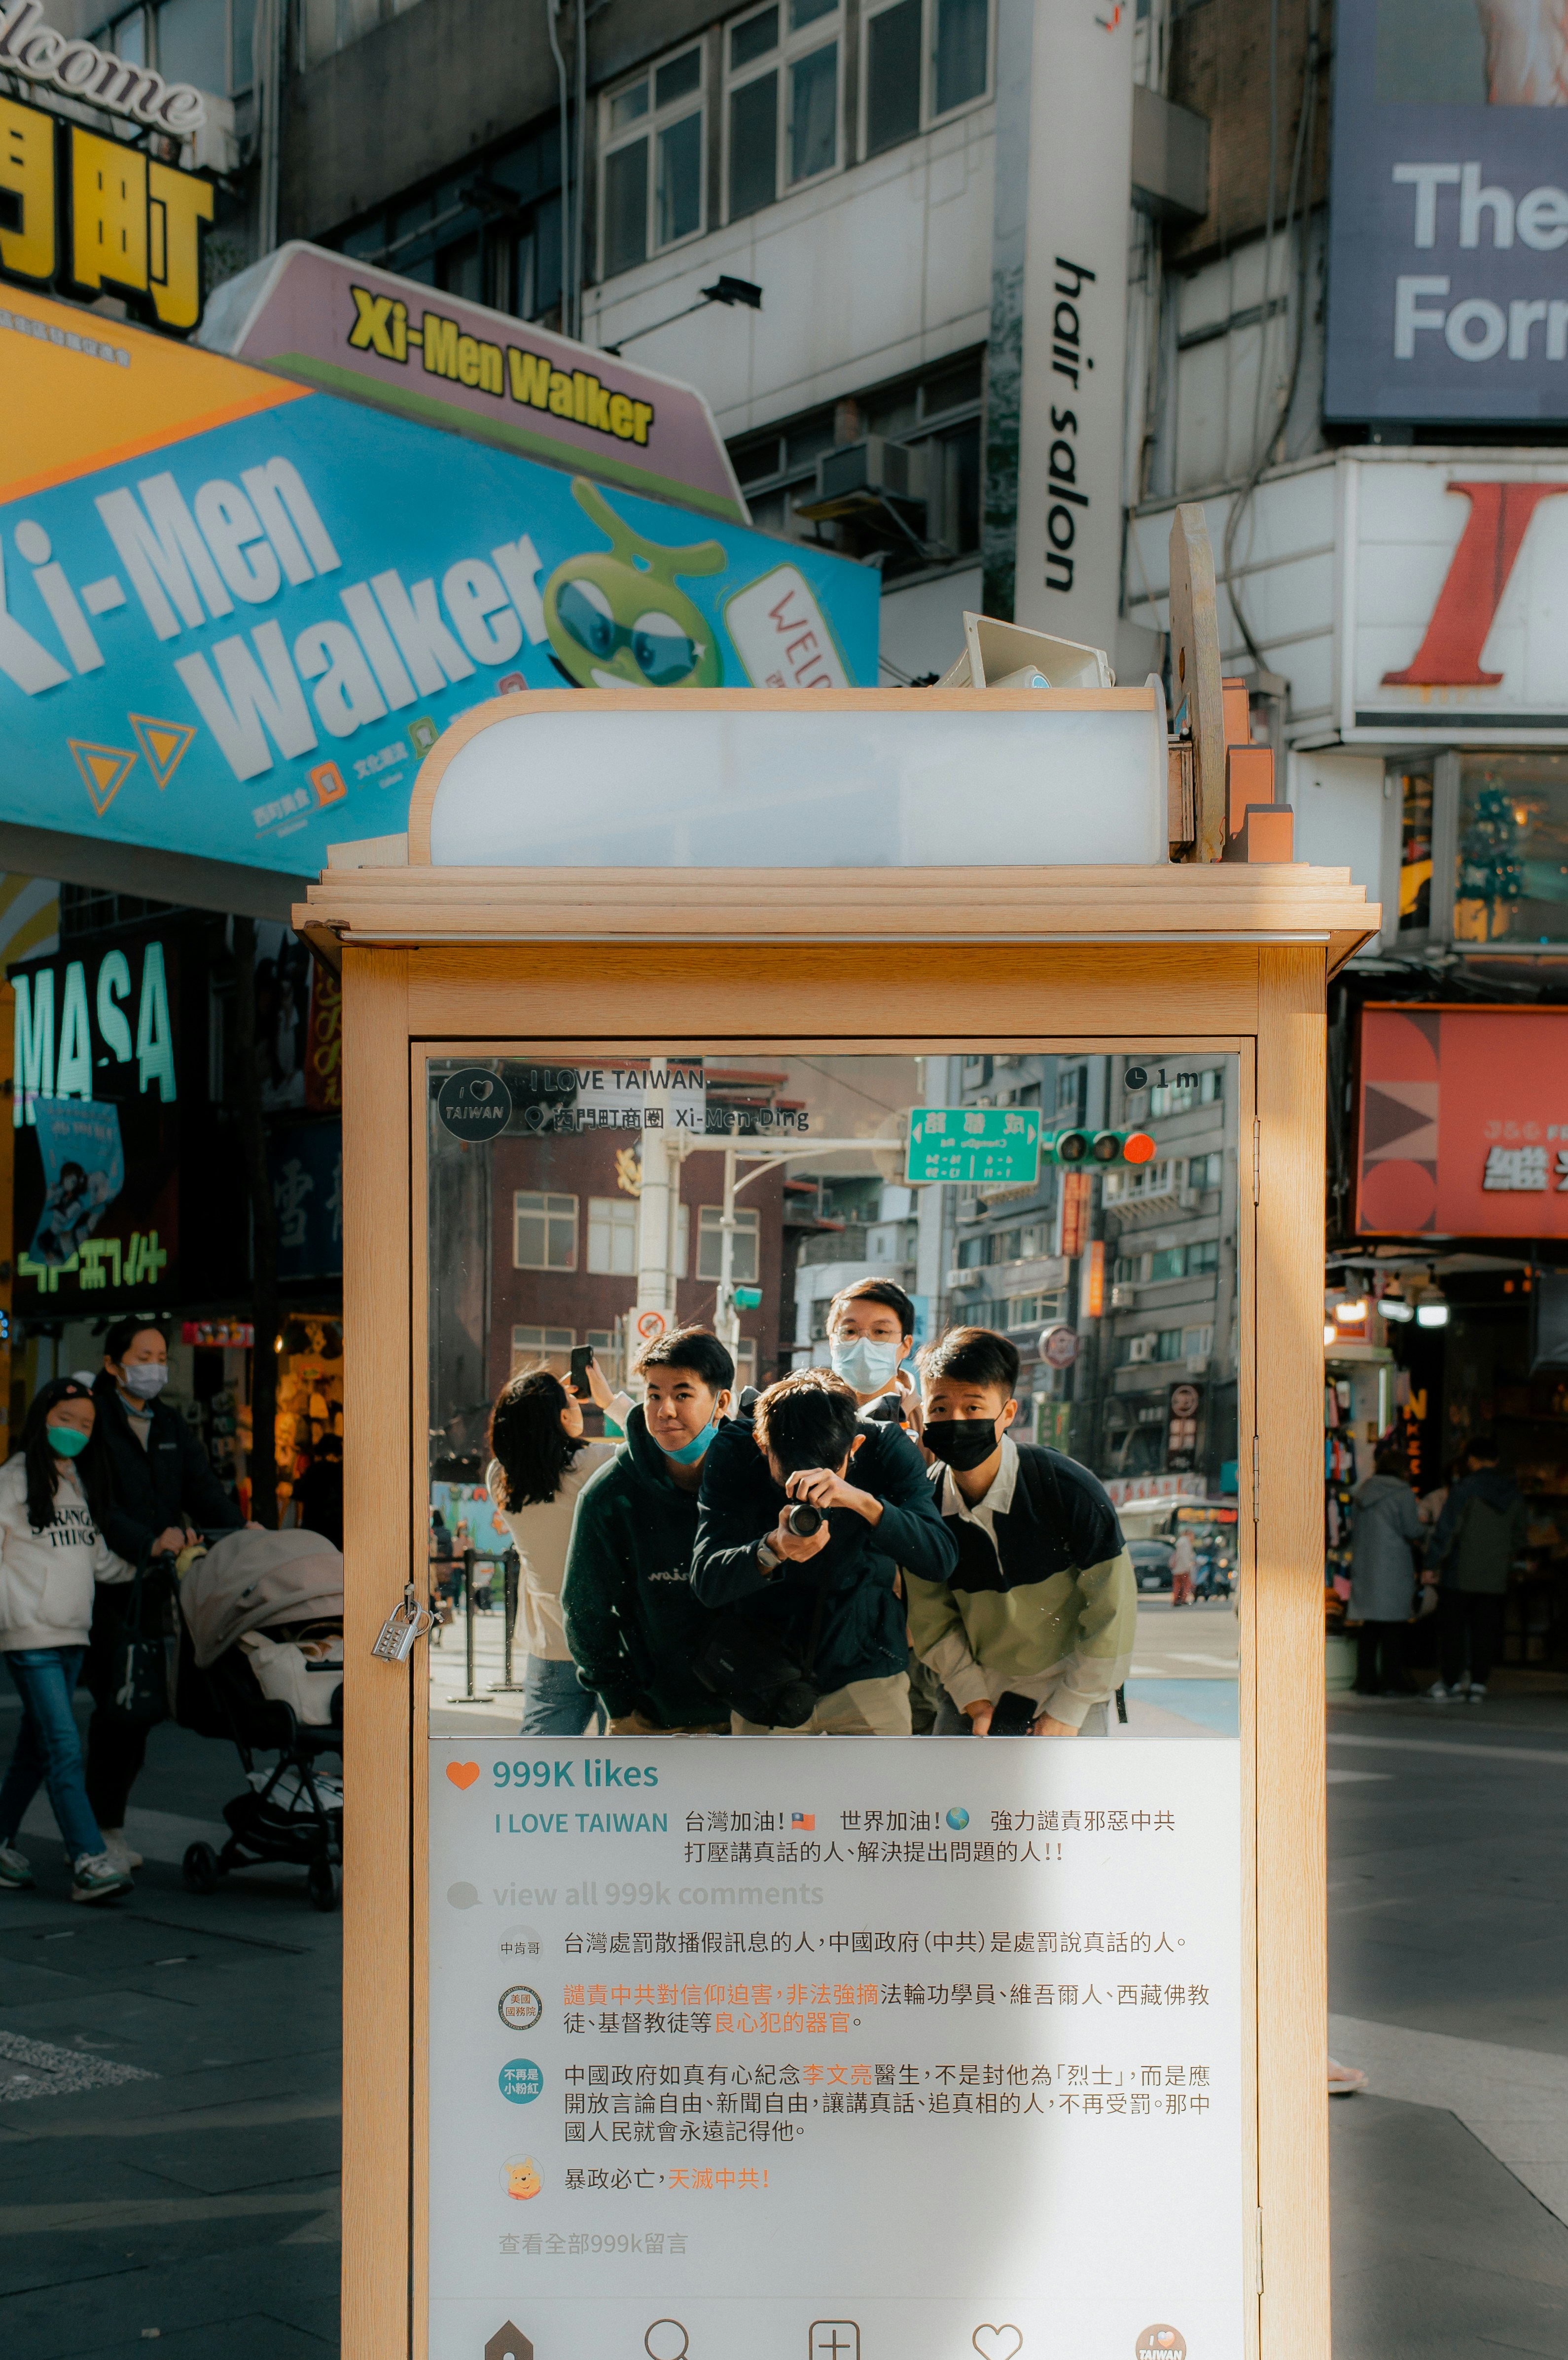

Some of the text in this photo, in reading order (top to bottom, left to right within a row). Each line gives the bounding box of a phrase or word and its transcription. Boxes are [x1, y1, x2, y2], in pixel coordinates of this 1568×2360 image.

[0, 0, 203, 131] lcome
[1392, 161, 1568, 251] The
[348, 285, 654, 447] Xi-Men Walker
[1045, 255, 1097, 593] hair salon
[173, 532, 548, 782] Walker
[531, 1069, 704, 1091] I LOVE TAIWAN
[1156, 1068, 1199, 1089] 1 m
[459, 1087, 464, 1099] I
[445, 1106, 504, 1119] TAIWAN
[553, 1107, 809, 1132] 西門町商圈 Xi-Men-Ding
[493, 1758, 659, 1788] 999K likes
[495, 1813, 668, 1834] I LOVE TAIWAN
[685, 1809, 1176, 1833] 台灣加油! 世界加油! 強力譴責邪惡中共
[493, 1881, 824, 1906] view all 999k comments
[501, 1942, 540, 1955] 中肯哥
[511, 1994, 530, 2004] 美國
[506, 2006, 536, 2017] 國務院
[504, 2068, 538, 2080] 不再是
[504, 2082, 539, 2095] 小粉紅
[498, 2231, 689, 2256] 查看全部999k留言
[1149, 2334, 1154, 2346] I
[1139, 2349, 1183, 2360] TAIWAN
